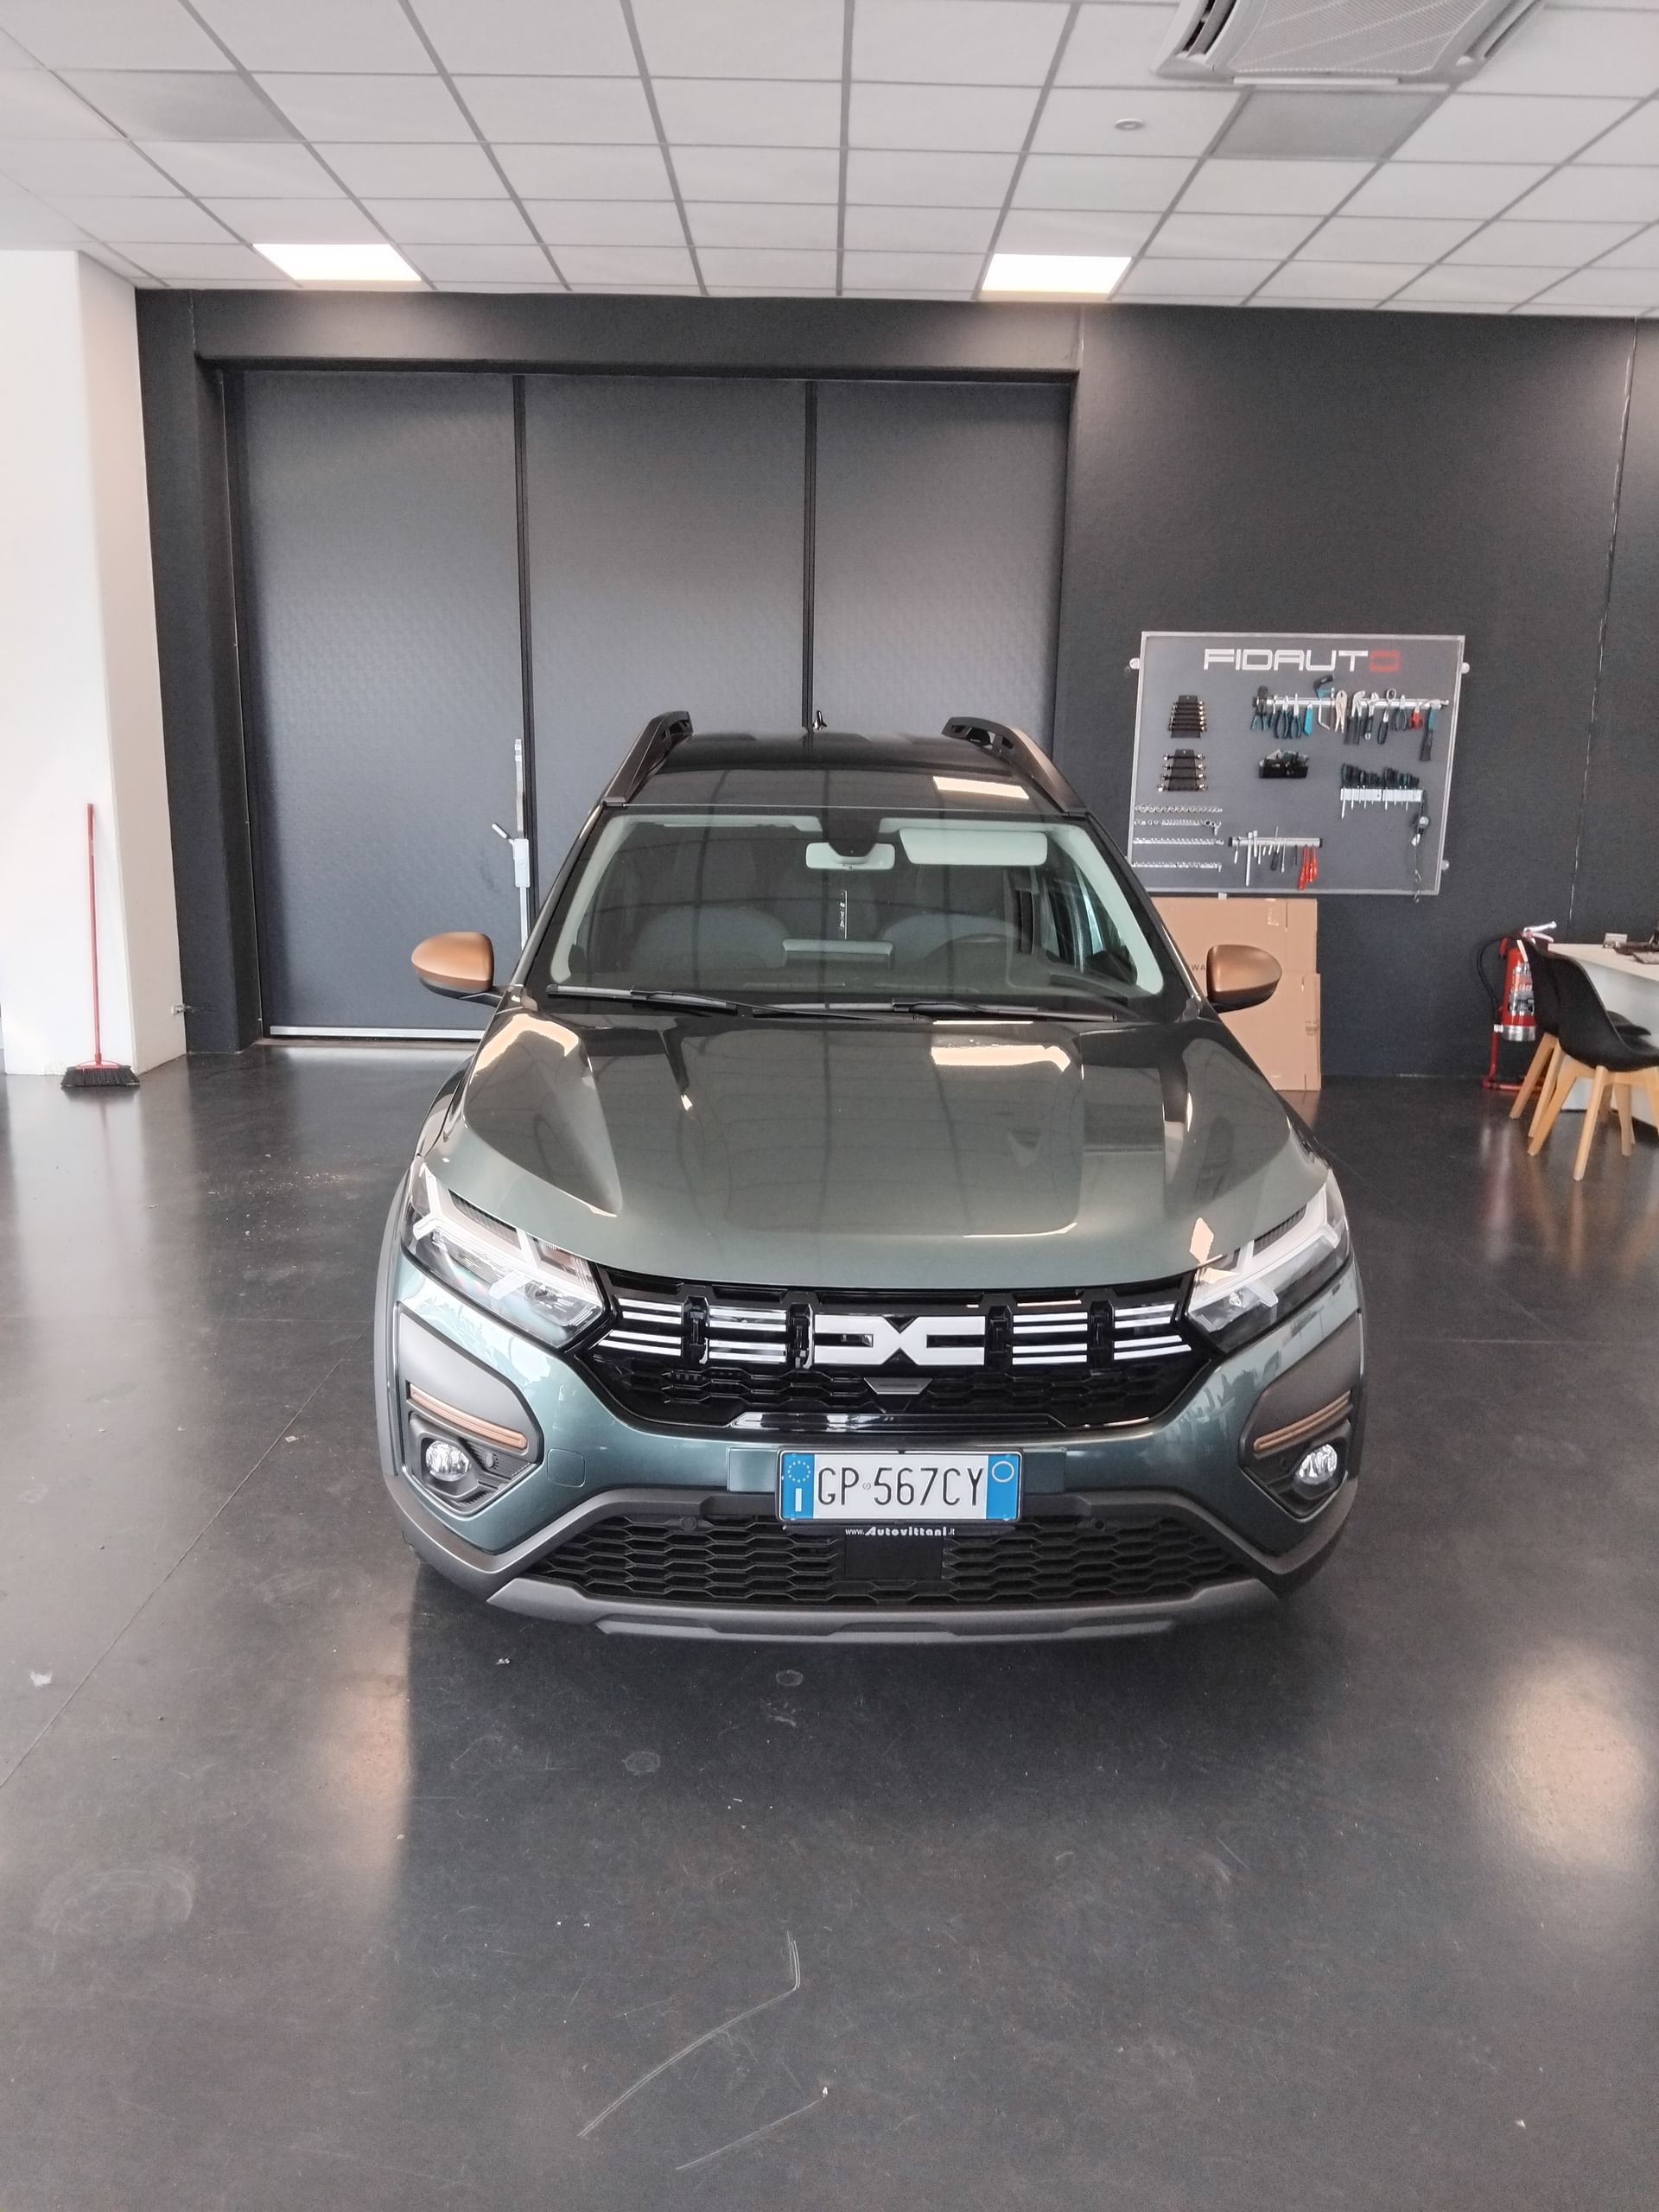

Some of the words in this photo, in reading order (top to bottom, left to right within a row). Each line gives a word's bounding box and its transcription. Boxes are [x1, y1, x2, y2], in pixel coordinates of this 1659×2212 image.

[1204, 649, 1400, 671] FIDAUTO
[817, 1467, 860, 1506] GP
[874, 1467, 983, 1506] 567CY
